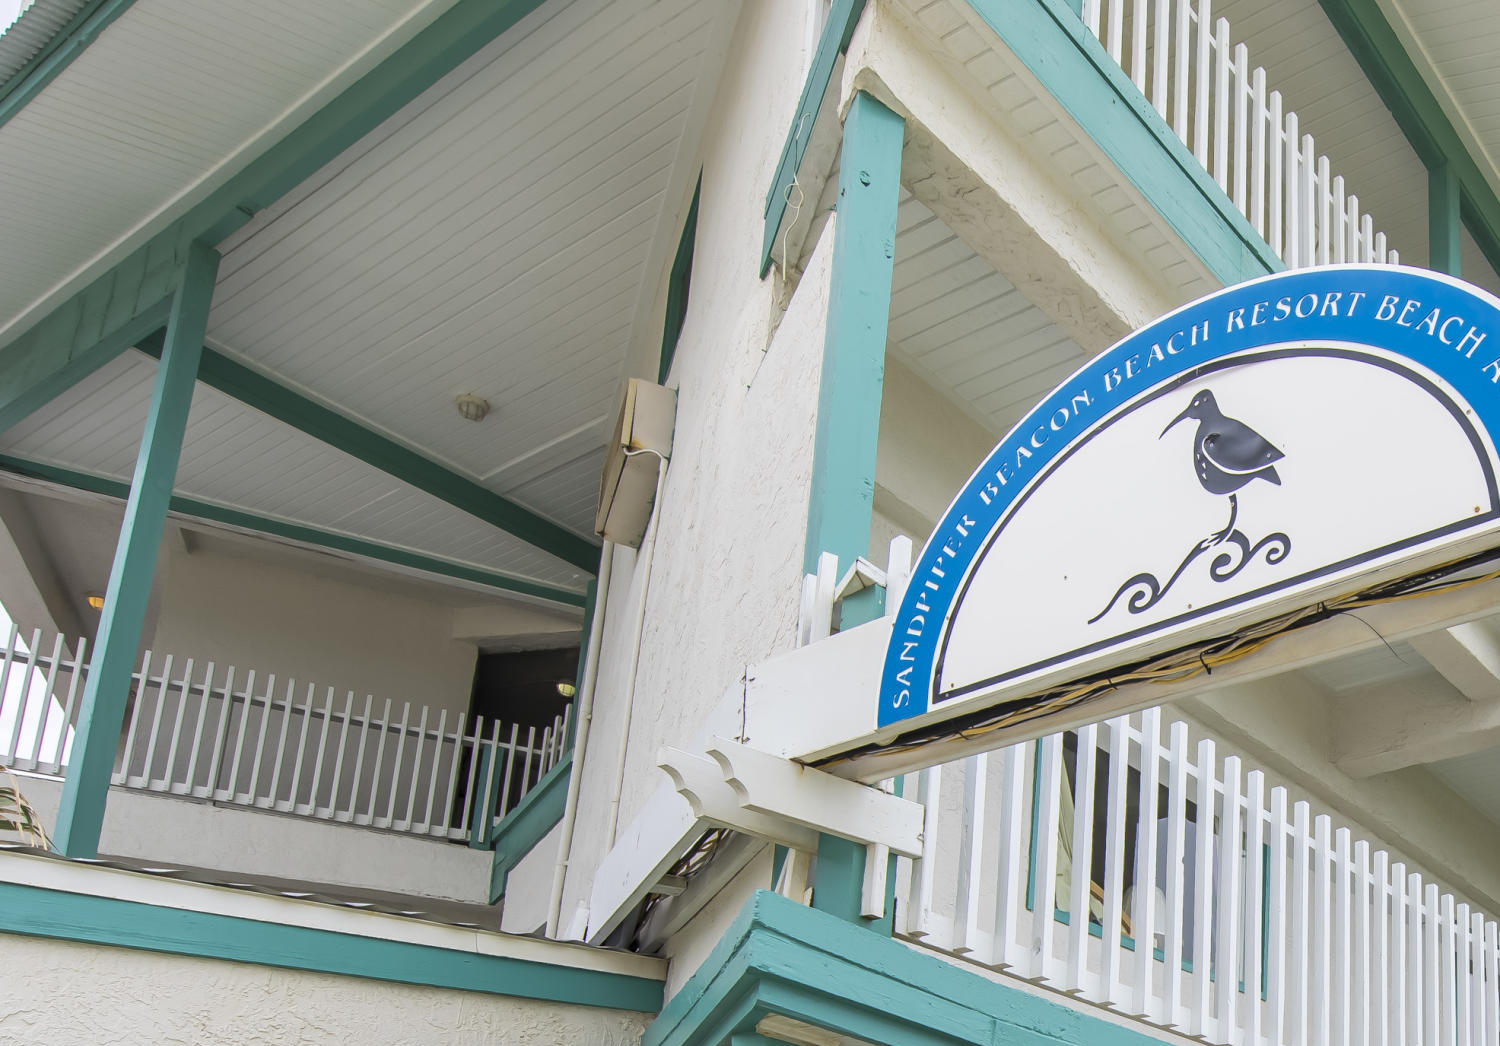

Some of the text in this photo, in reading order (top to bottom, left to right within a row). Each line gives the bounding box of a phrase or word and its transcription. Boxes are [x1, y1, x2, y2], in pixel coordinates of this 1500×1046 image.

[893, 513, 976, 708] SANDPIPER
[979, 389, 1091, 506] BEACON
[1103, 318, 1209, 392] BEACH
[1226, 291, 1365, 334] RESORT
[1375, 295, 1486, 359] BEACH
